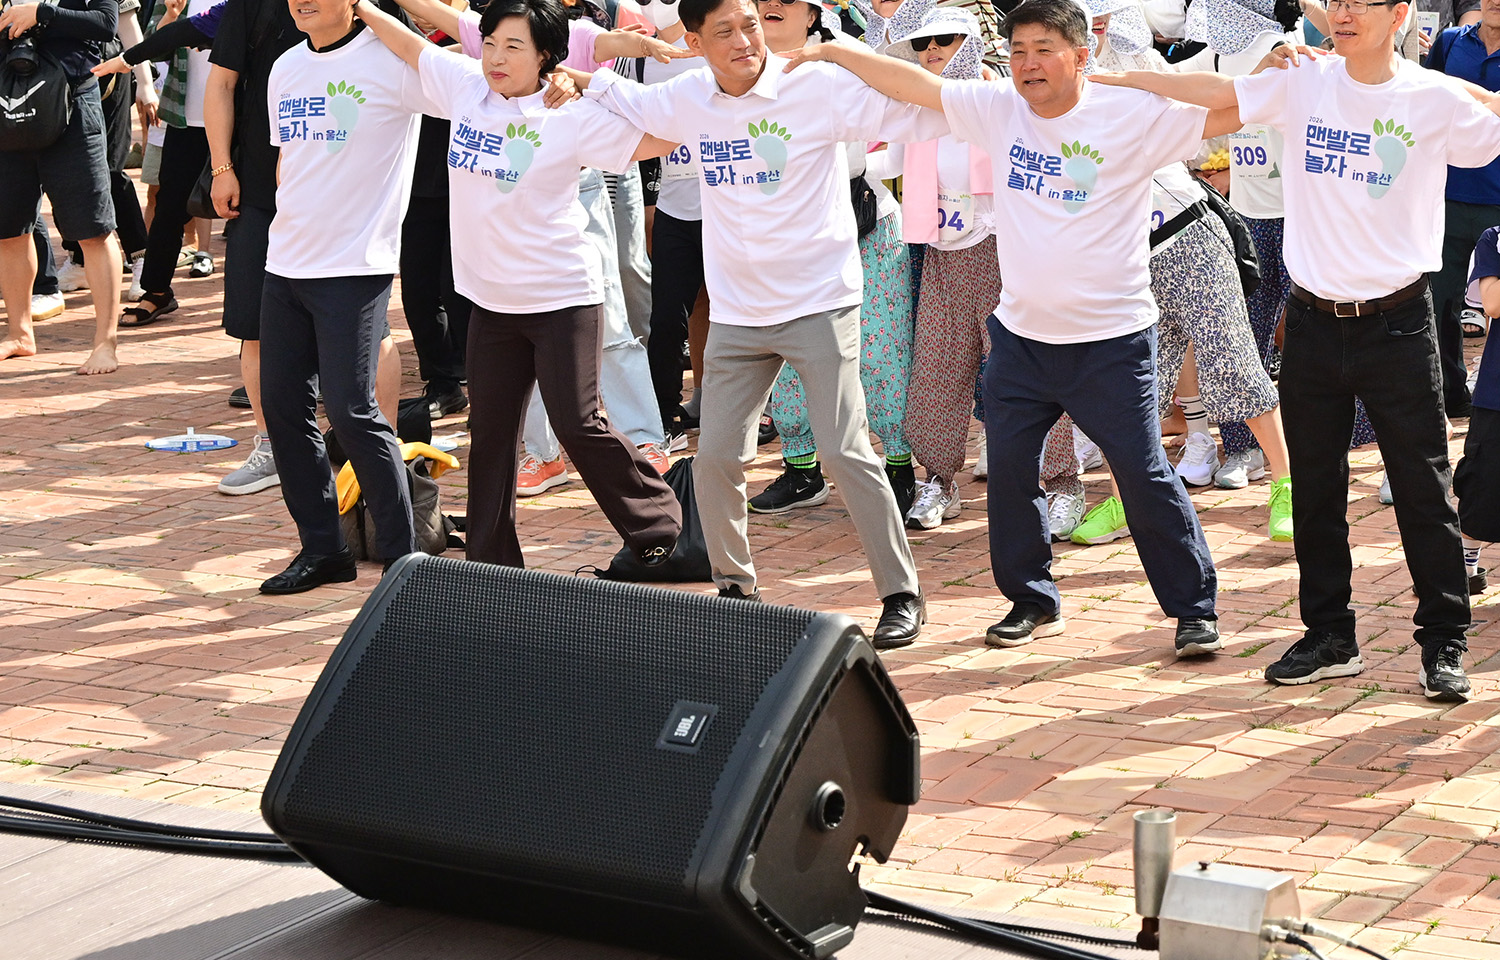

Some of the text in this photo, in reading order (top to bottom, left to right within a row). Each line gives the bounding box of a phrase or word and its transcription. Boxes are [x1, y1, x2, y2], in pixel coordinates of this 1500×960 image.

[278, 96, 326, 120] 맨발로
[1308, 116, 1324, 124] 2026
[279, 120, 348, 142] 놀자 in 울산
[453, 122, 504, 156] 맨발로
[1306, 124, 1371, 156] 맨발로
[700, 138, 752, 162] 맨발로
[1009, 144, 1062, 177] 맨발로
[1234, 146, 1267, 166] 309
[448, 144, 519, 182] 놀자 in 울산
[702, 164, 780, 186] 놀자 in 울산
[1304, 150, 1392, 186] 놀자 in 울산
[1007, 167, 1088, 202] 놀자 in 울산
[674, 715, 696, 737] JBL
